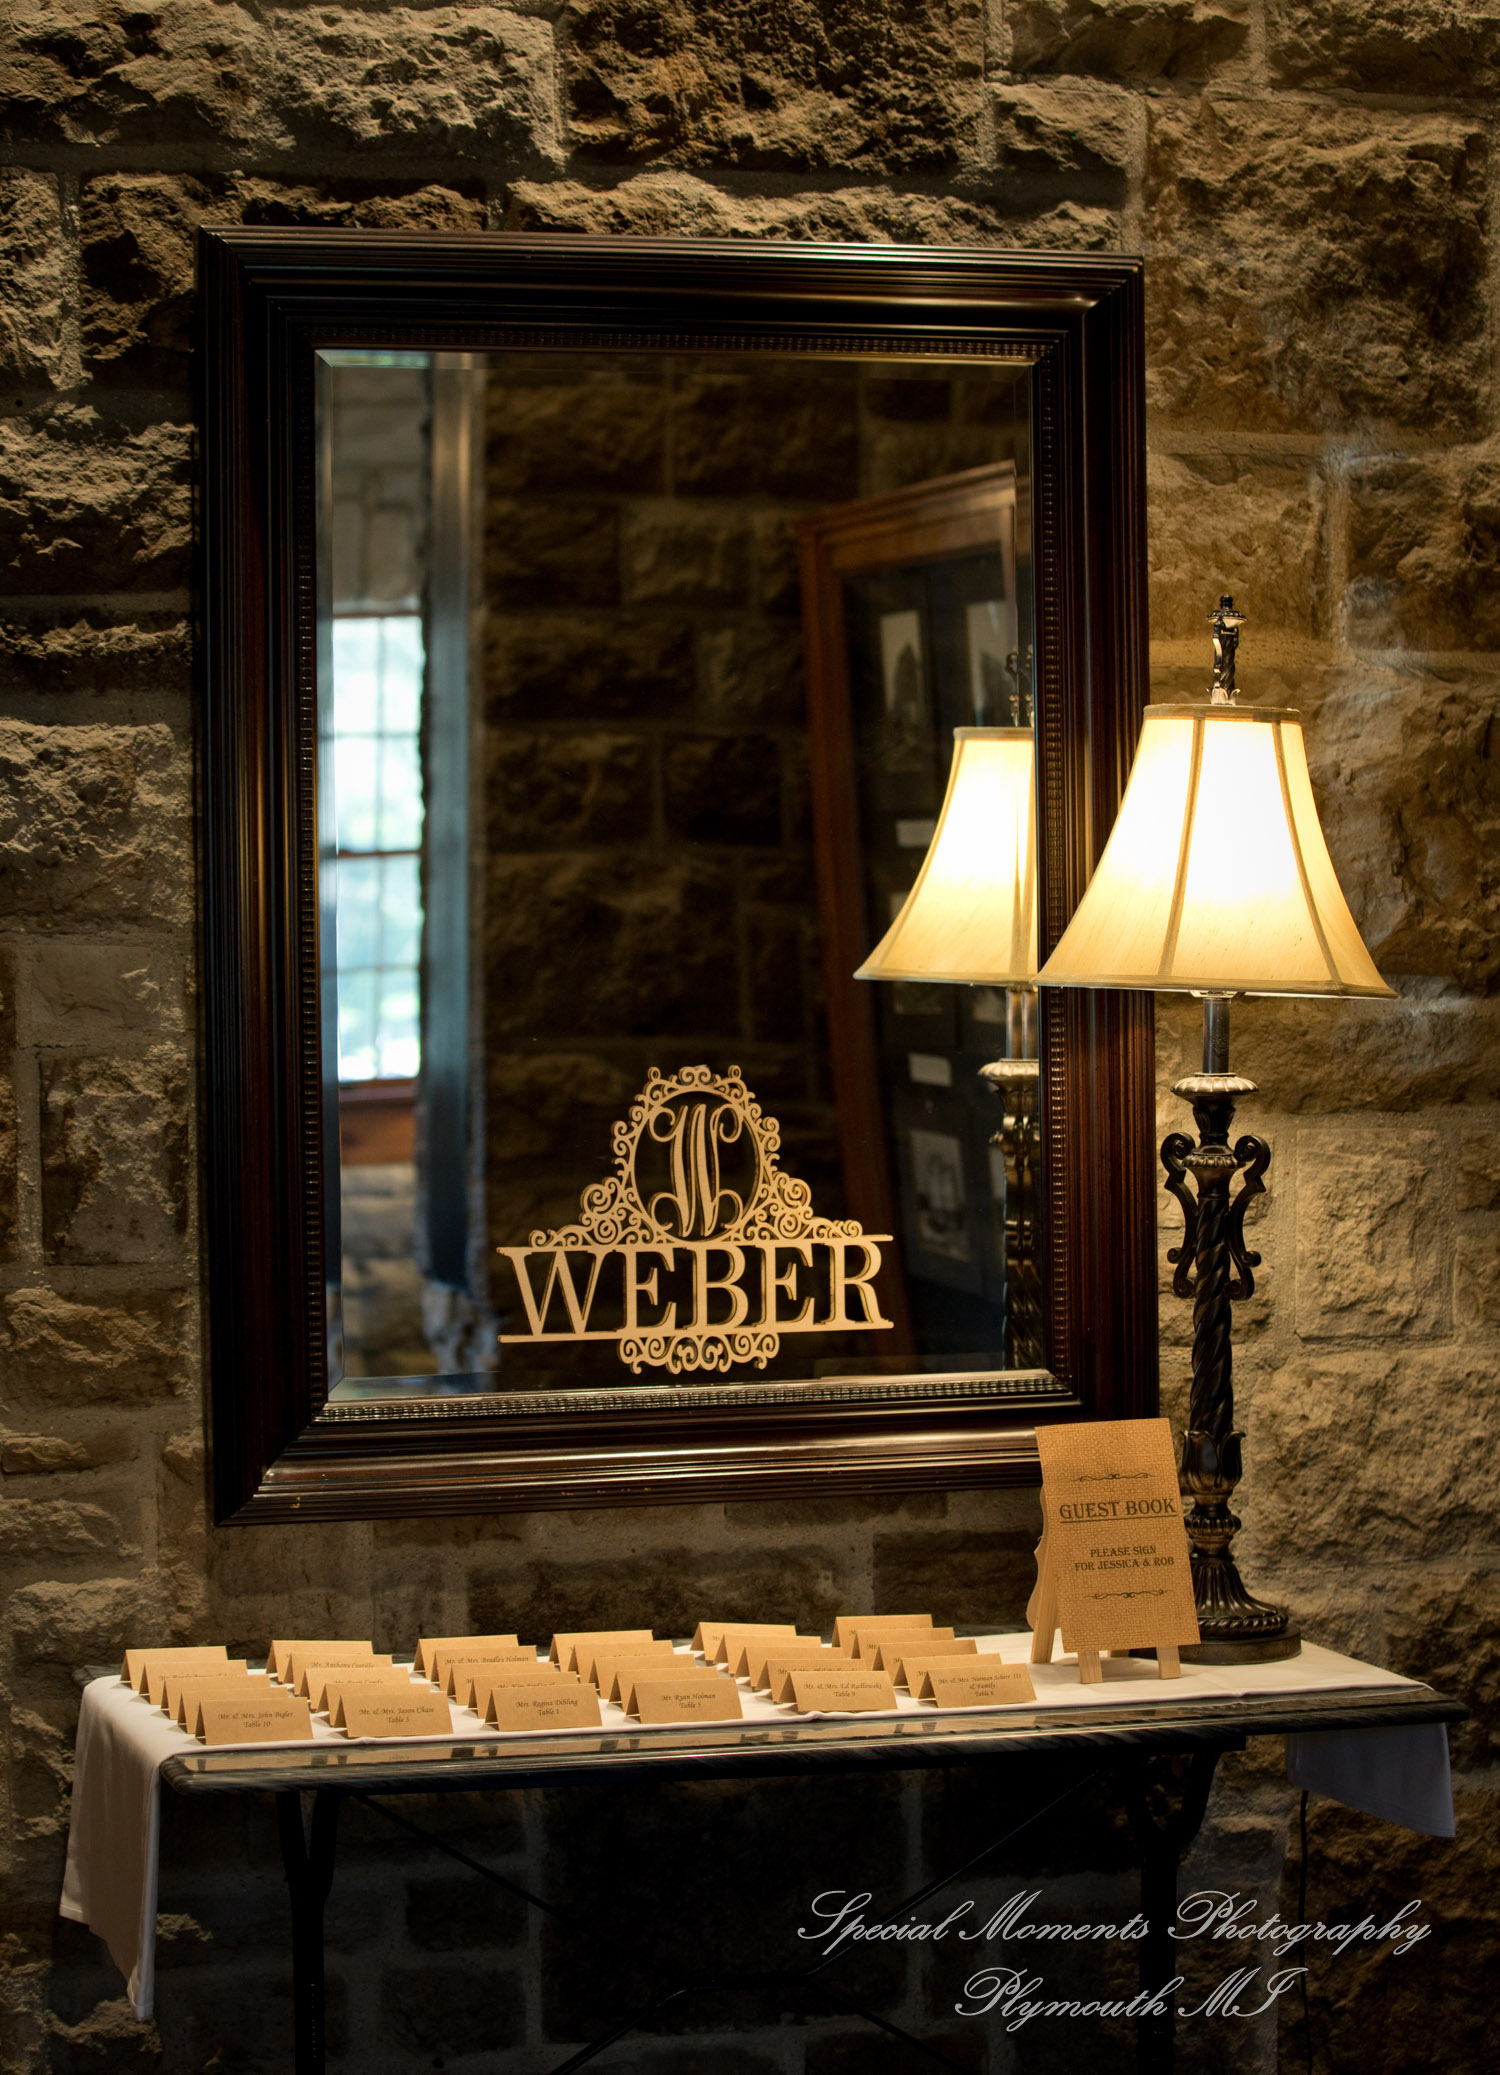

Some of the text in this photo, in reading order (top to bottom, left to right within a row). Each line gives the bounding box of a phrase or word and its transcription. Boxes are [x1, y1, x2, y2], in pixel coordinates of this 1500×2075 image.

[498, 1237, 893, 1342] WEBER
[1060, 1498, 1176, 1519] GUEST BOOK
[1090, 1545, 1156, 1558] PLEASE SIGN
[1075, 1557, 1175, 1571] FOR JESSICA & ROB
[675, 1694, 691, 1702] Ryan
[258, 1711, 273, 1719] John
[398, 1707, 415, 1715] Jason
